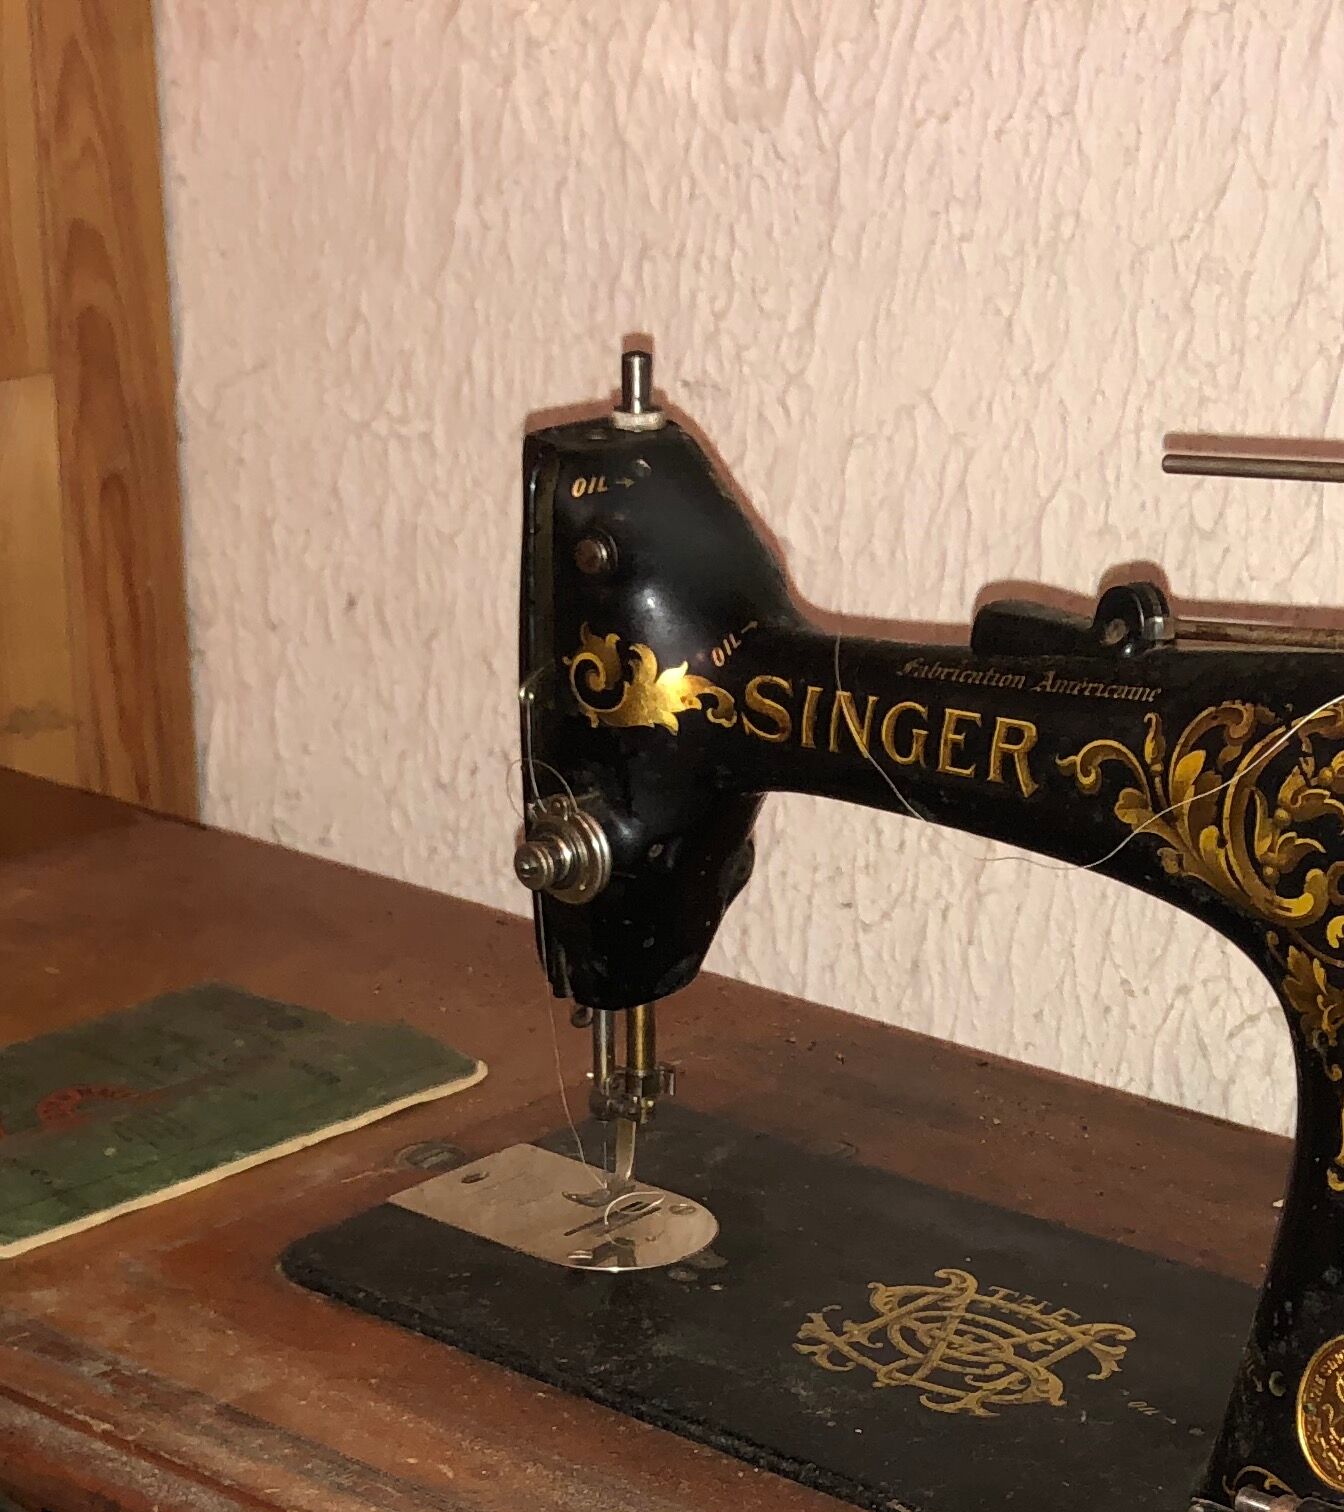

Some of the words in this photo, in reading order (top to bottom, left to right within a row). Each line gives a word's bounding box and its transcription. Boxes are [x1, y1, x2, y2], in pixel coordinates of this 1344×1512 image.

[570, 476, 608, 498] OIL
[712, 633, 742, 667] OIL
[741, 674, 1040, 798] SINGER
